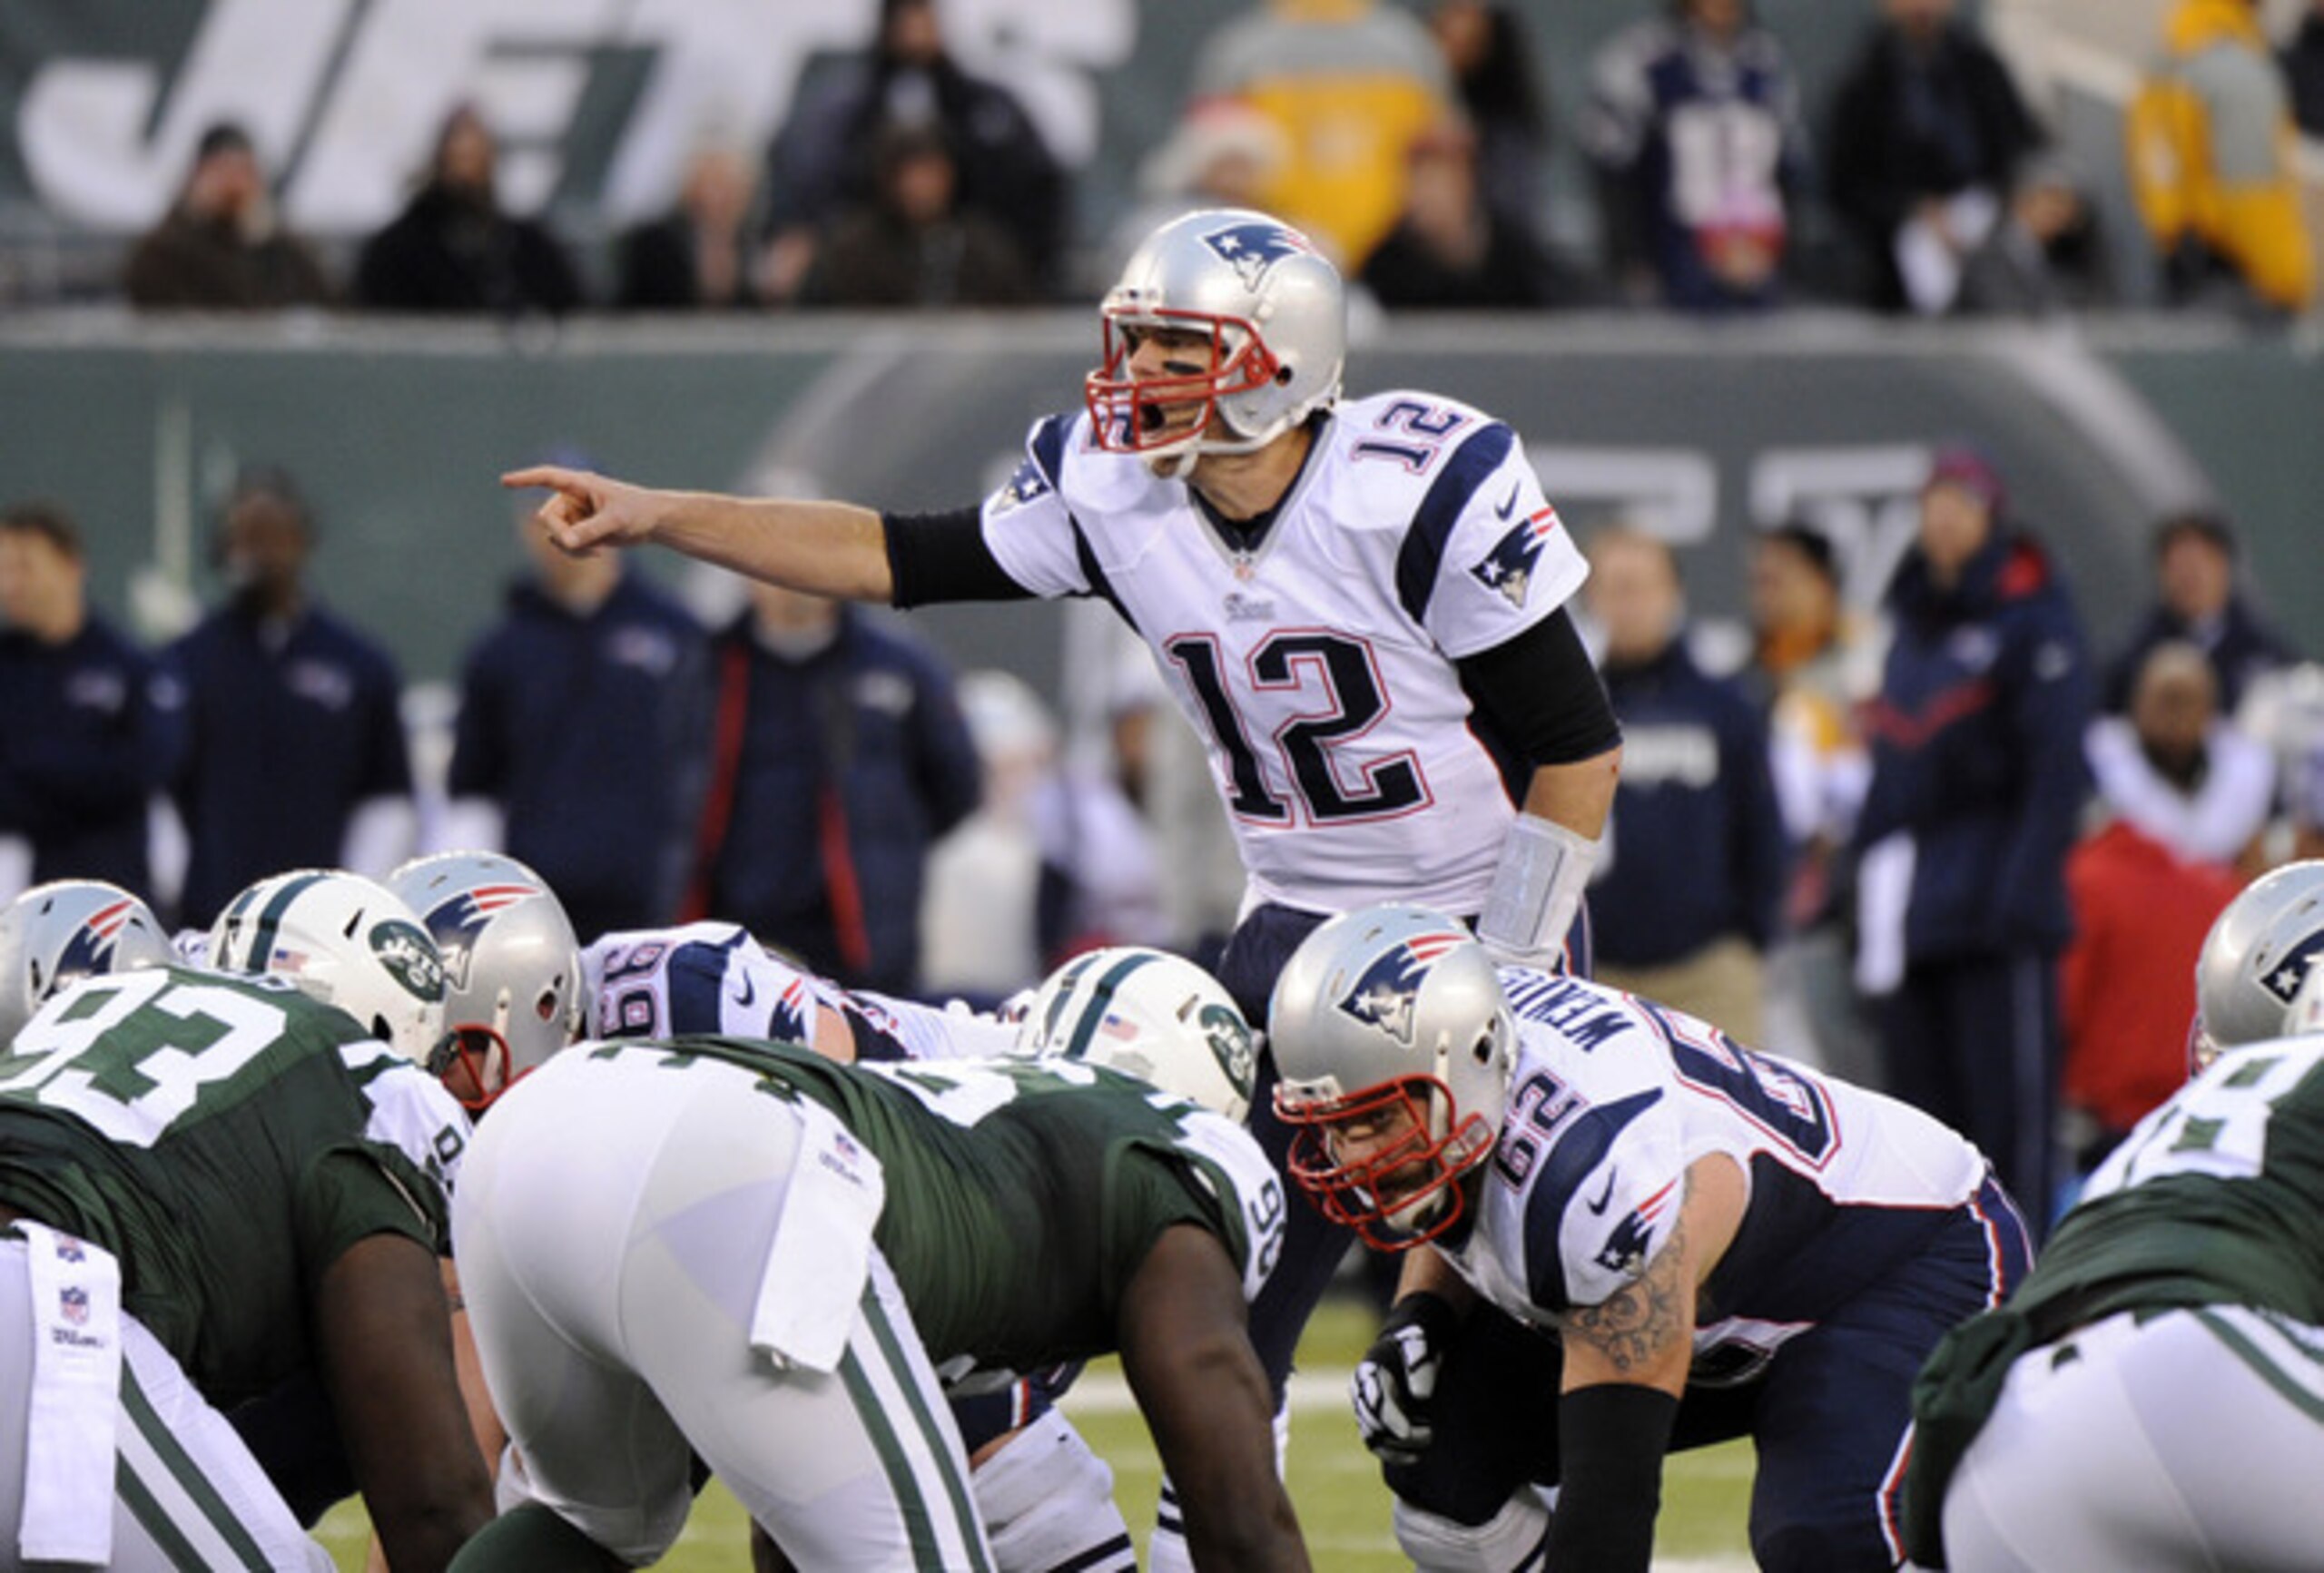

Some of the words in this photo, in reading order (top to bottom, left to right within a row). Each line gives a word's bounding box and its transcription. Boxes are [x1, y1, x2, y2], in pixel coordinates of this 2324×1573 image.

[1349, 397, 1475, 477] 12
[1163, 626, 1434, 830] 12
[0, 968, 288, 1150] 93
[1492, 1067, 1592, 1196] 62
